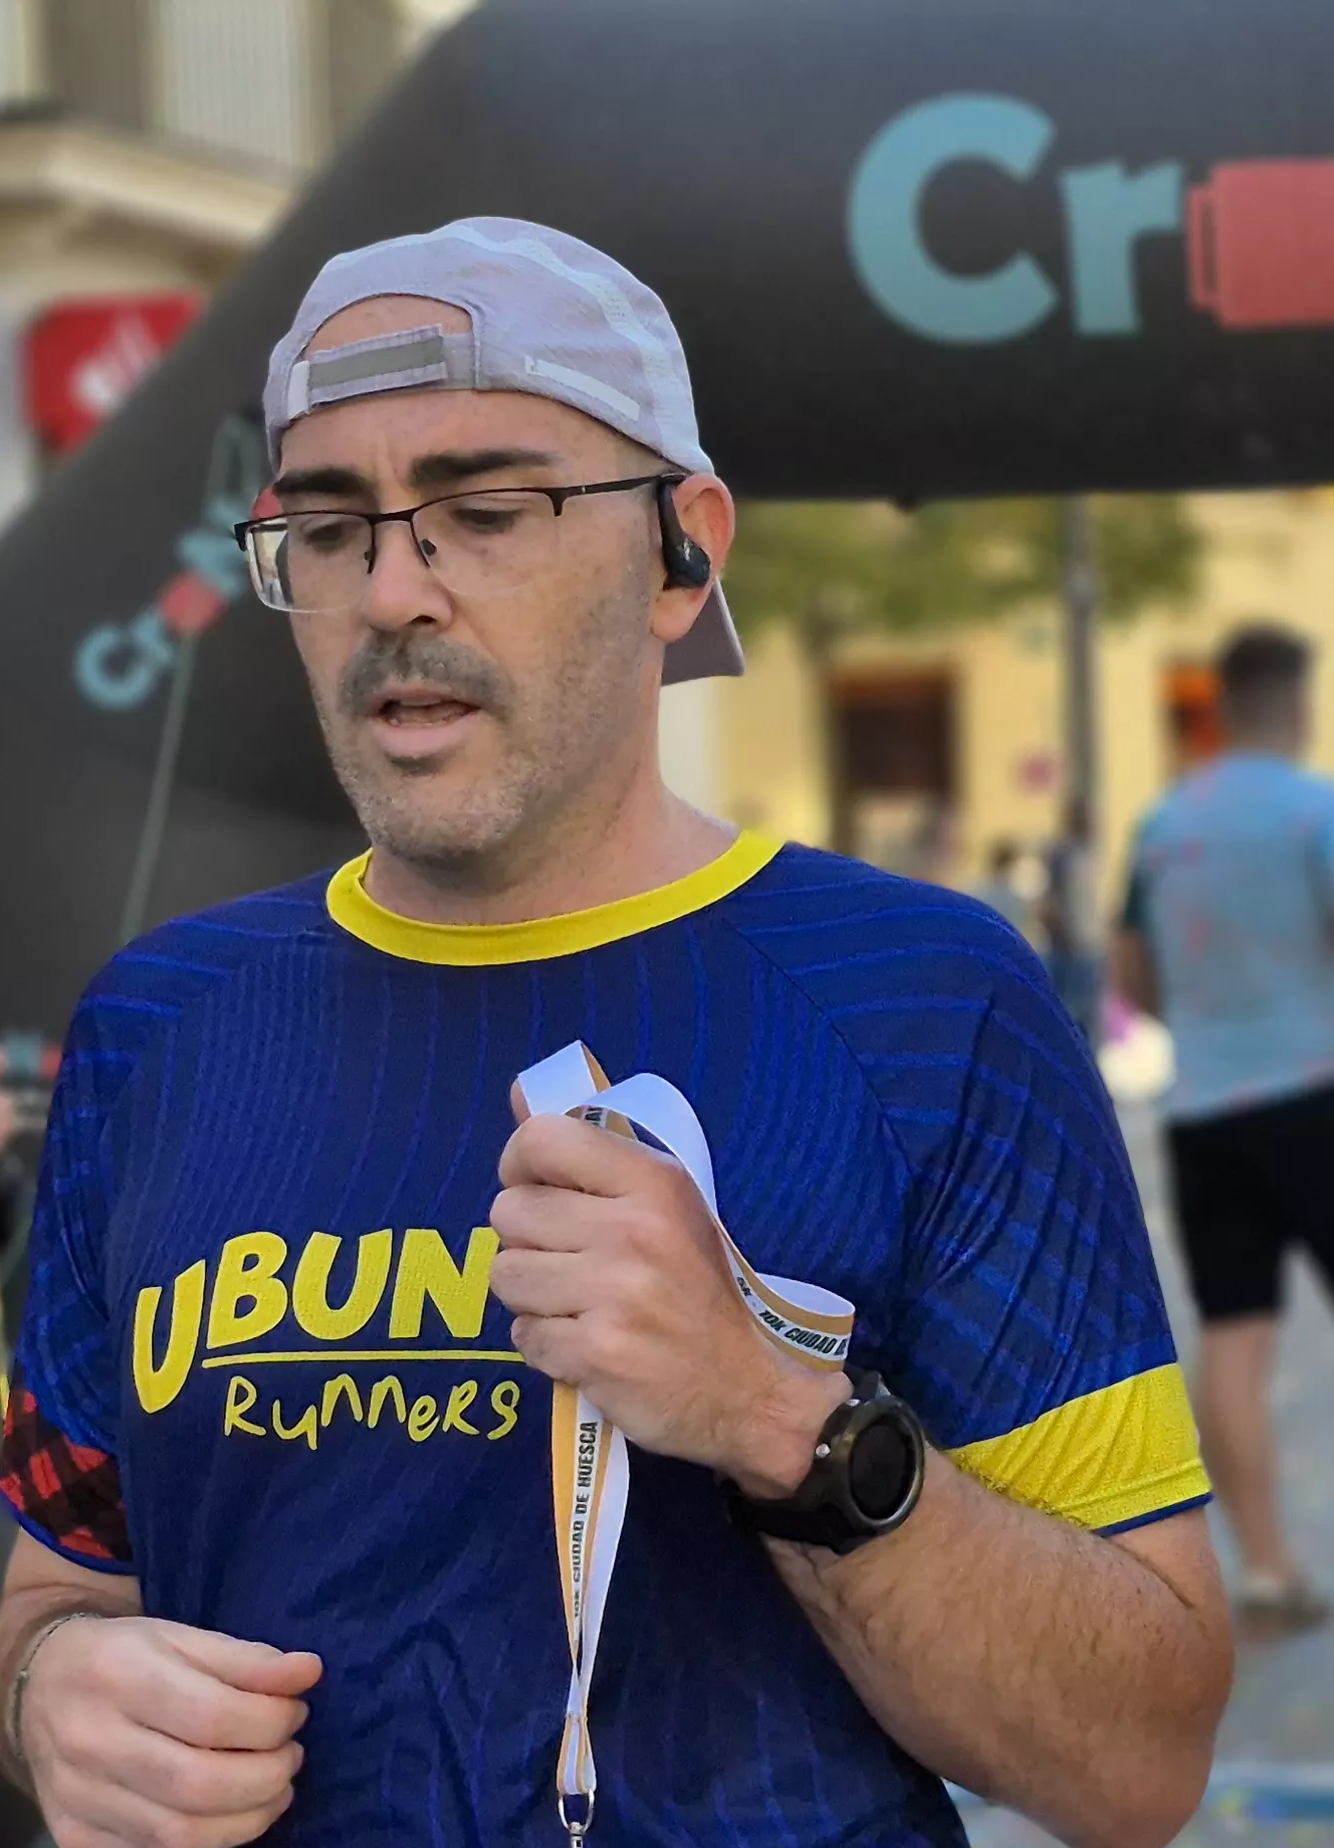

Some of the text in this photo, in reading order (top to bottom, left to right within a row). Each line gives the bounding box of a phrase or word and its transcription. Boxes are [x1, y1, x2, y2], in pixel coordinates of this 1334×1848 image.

[758, 1308, 788, 1332] 10K
[784, 1327, 838, 1355] CIUDAD
[576, 1421, 599, 1488] HUESCA
[574, 1493, 590, 1515] DE
[571, 1520, 585, 1583] CIUDAD
